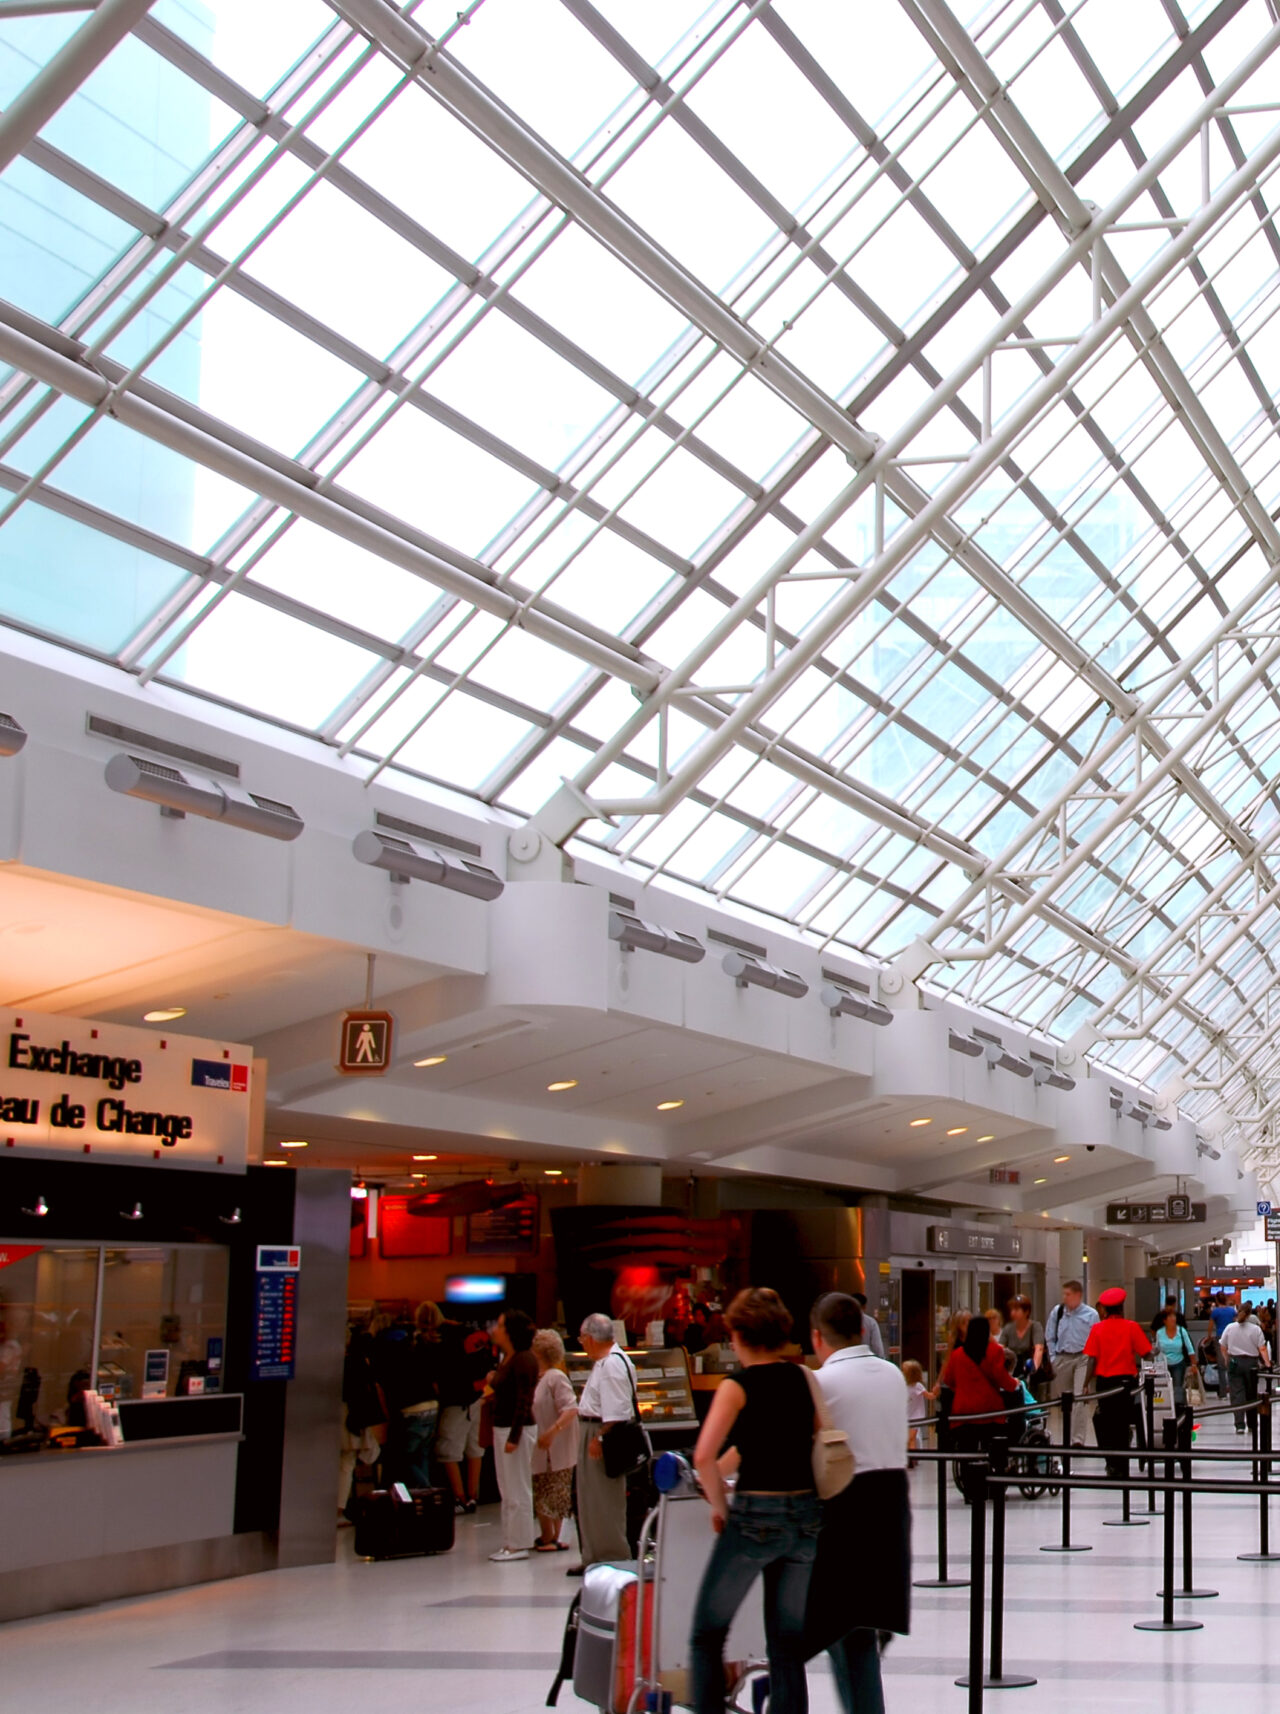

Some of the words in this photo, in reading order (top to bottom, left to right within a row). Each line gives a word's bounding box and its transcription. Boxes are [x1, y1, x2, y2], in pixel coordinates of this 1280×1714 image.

[9, 1033, 142, 1090] Exchange
[0, 1096, 40, 1124] au
[50, 1094, 86, 1129] de
[97, 1098, 193, 1146] Change
